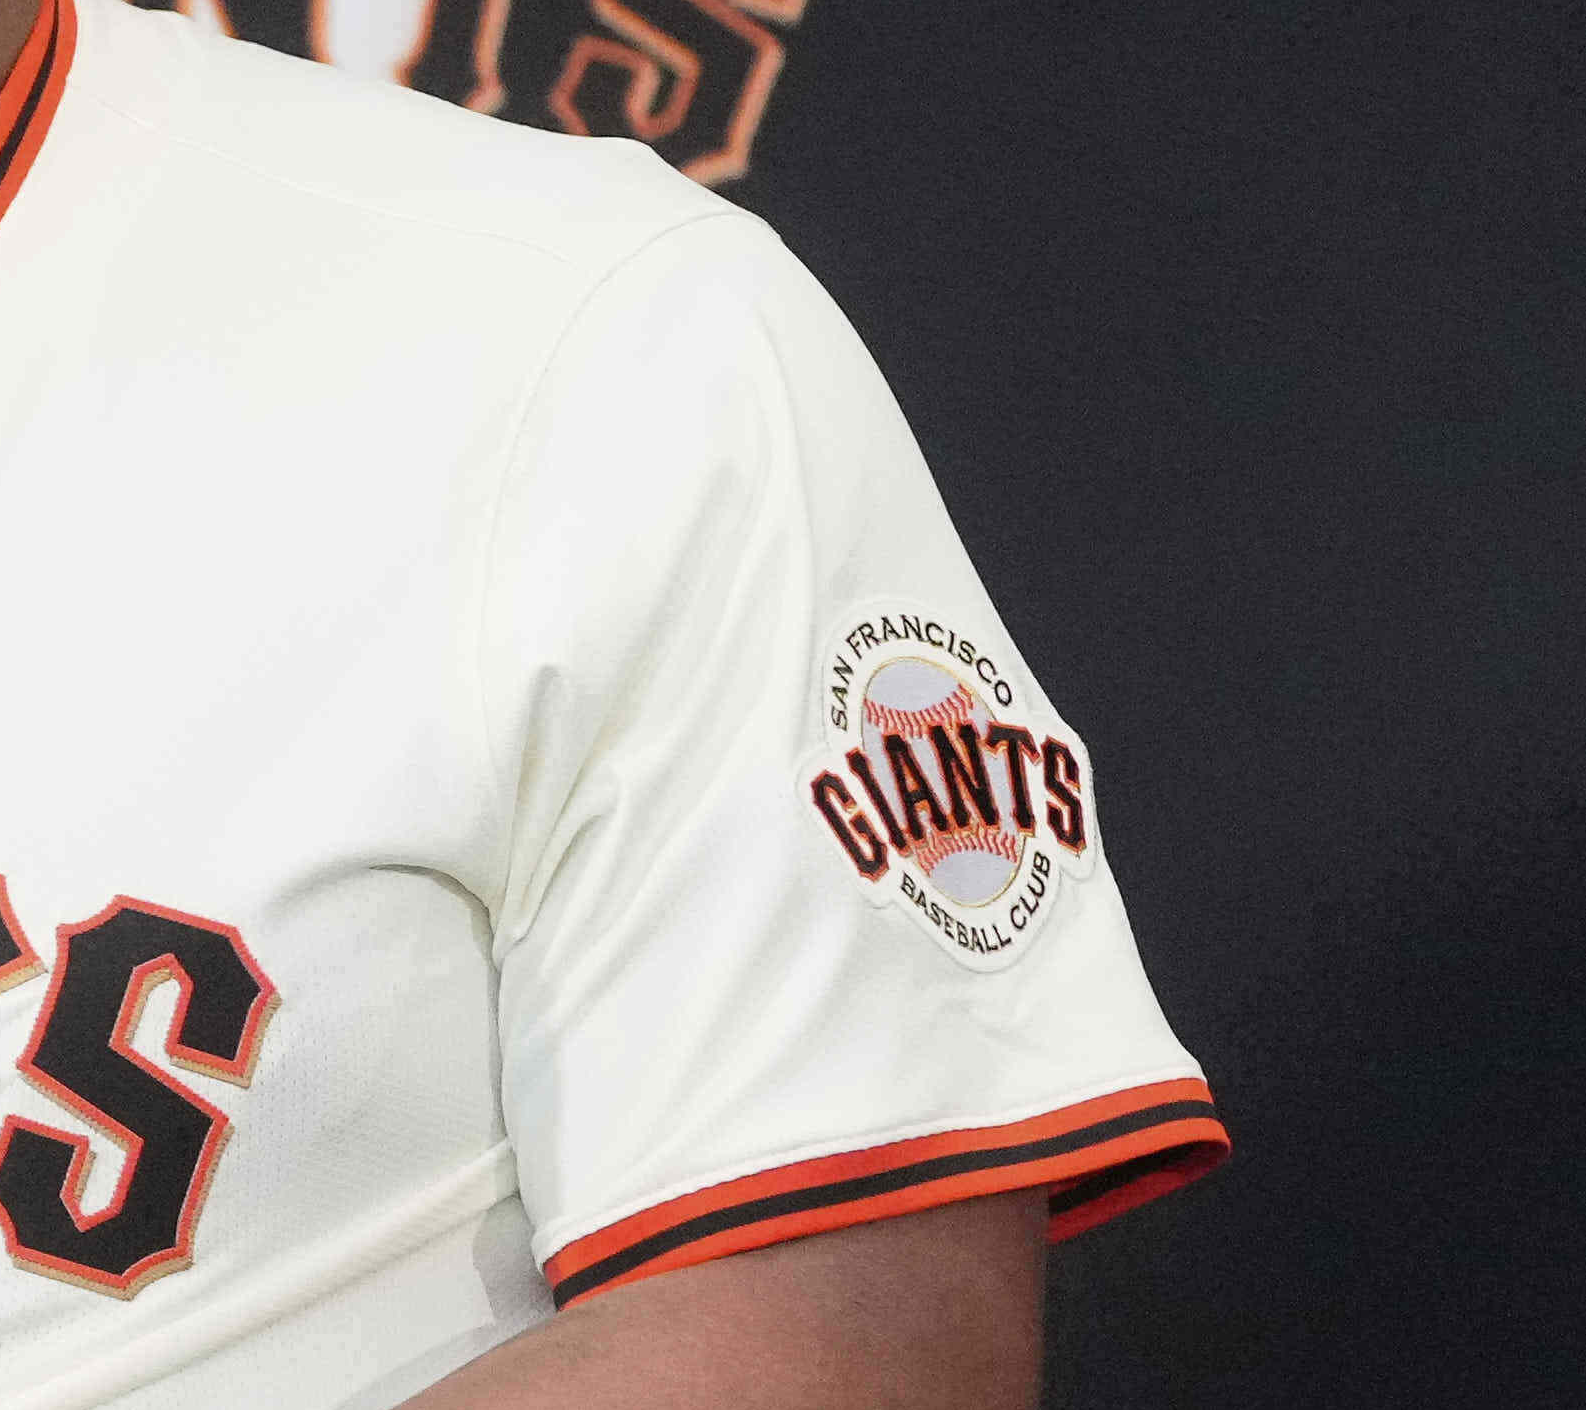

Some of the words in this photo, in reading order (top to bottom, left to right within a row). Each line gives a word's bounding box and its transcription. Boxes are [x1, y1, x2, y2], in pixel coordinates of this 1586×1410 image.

[831, 655, 855, 732] SAN
[846, 614, 1013, 707] FRANCISCO
[810, 721, 1087, 882] GIANTS
[900, 872, 1013, 954] BASEBALL
[1009, 851, 1050, 930] CLUB
